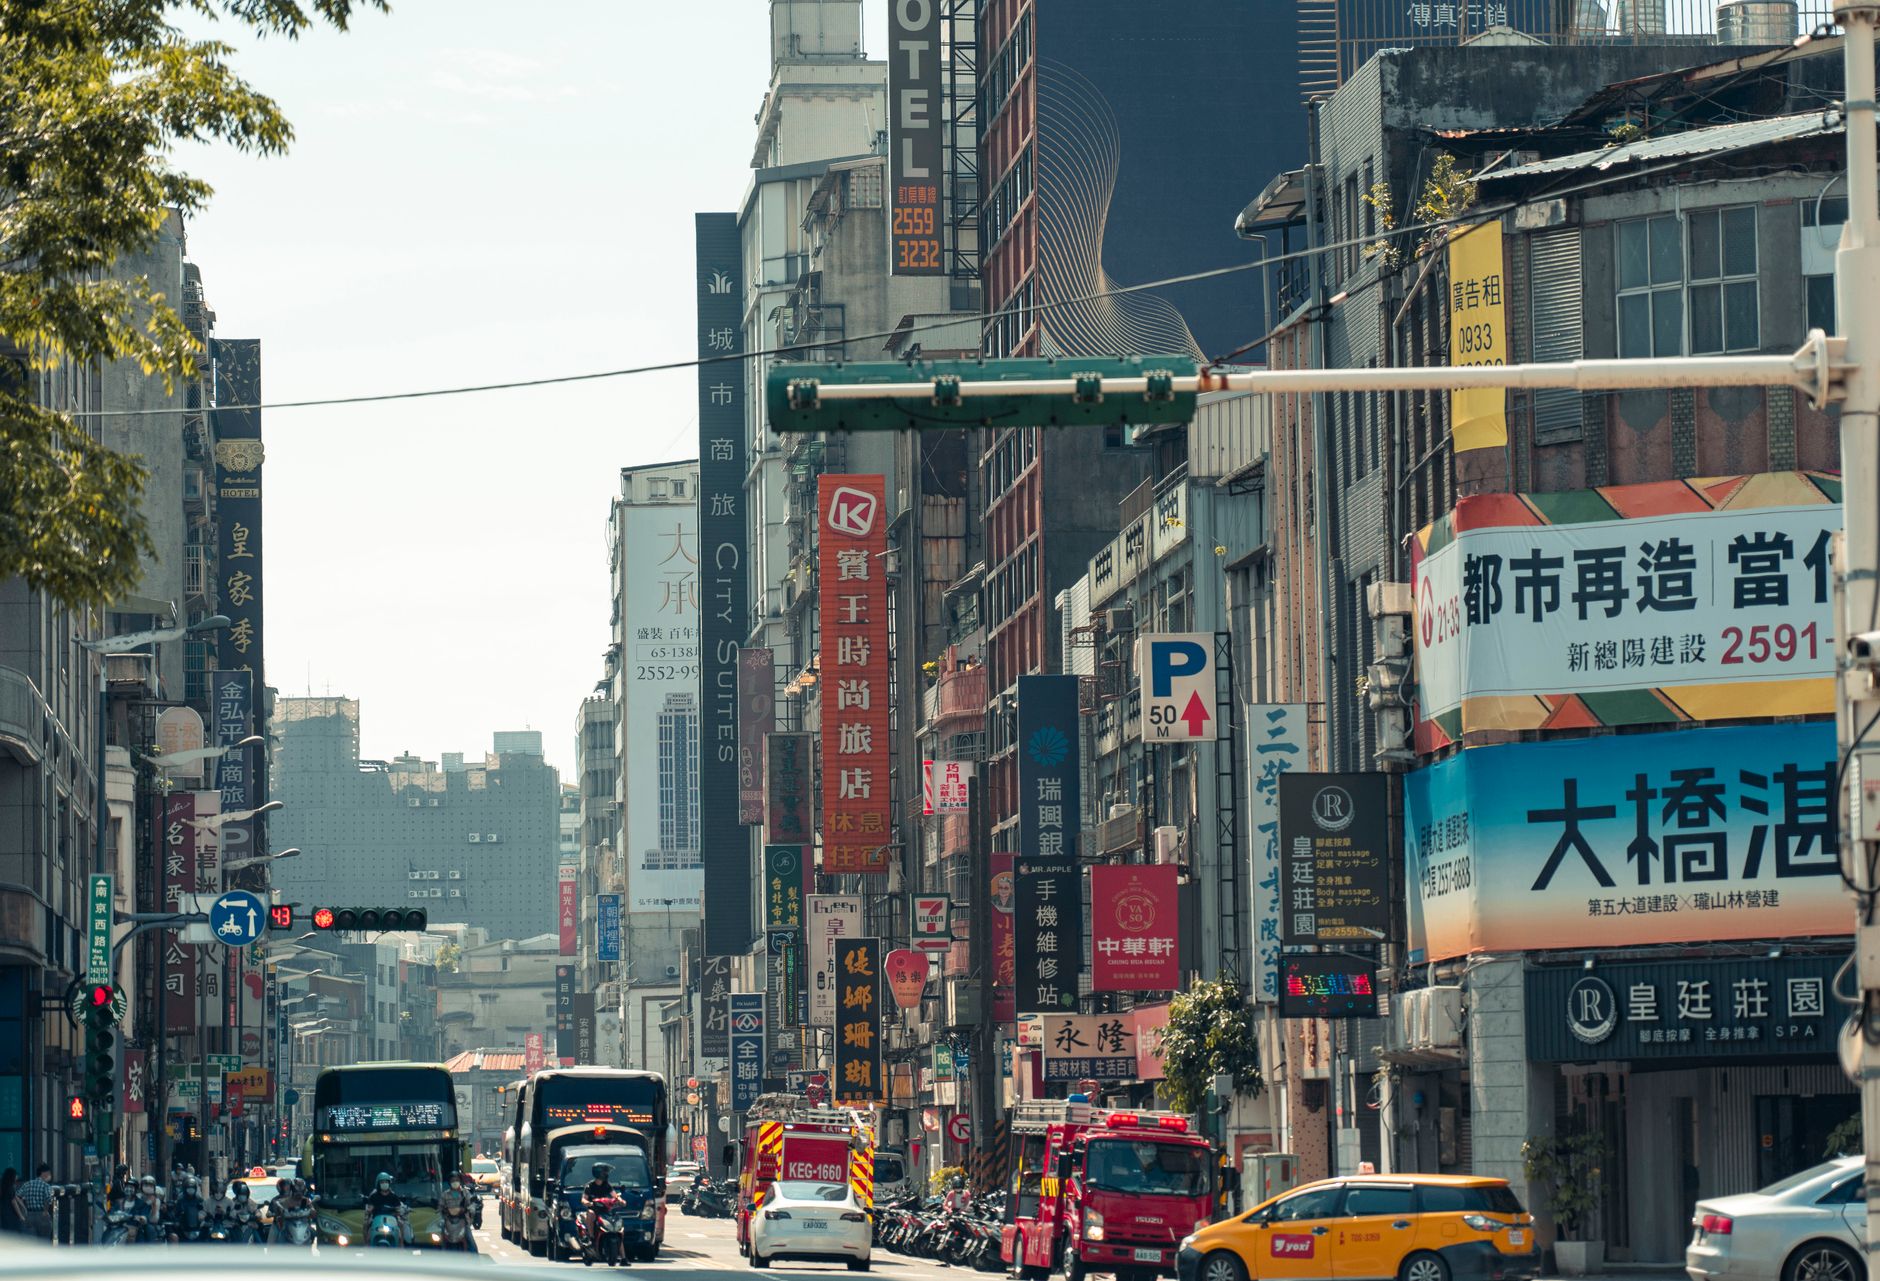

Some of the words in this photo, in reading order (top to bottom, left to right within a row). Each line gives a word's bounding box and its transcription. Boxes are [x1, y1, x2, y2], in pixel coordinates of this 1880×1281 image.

[1407, 2, 1507, 27] 傳真行銷
[893, 207, 934, 235] 2559
[899, 240, 940, 268] 3232
[1452, 274, 1502, 313] 廣告租
[1459, 322, 1493, 354] 0933
[707, 327, 736, 516] 城市商旅
[222, 489, 258, 498] HOTEL
[227, 521, 254, 672] 皇家季
[716, 542, 739, 624] CITY
[1463, 538, 1699, 627] 都市再造
[637, 627, 663, 641] 盛裝
[669, 627, 703, 641] 百年
[1151, 641, 1207, 697] P
[1567, 633, 1707, 673] 新總陽建設
[836, 549, 873, 800] 賓王時尚旅店
[717, 638, 741, 762] SUITES
[1149, 705, 1177, 725] 50
[220, 680, 245, 813] 金弘平價商旅
[1157, 726, 1169, 737] M
[829, 812, 886, 833] 休息
[1527, 760, 1839, 892] 大橋湛
[1315, 849, 1334, 857] Foot
[1337, 850, 1370, 858] massage
[1291, 835, 1315, 937] 皇廷莊園
[1316, 888, 1335, 897] Body
[94, 886, 108, 947] 南京西路
[166, 821, 189, 997] 名家西公司
[271, 905, 291, 926] 43
[1588, 893, 1679, 917] 第五大道建設
[1036, 879, 1059, 1006] 手機維修站
[1097, 937, 1175, 957] 中華軒
[1627, 977, 1825, 1021] 皇廷莊園
[579, 1017, 590, 1059] 安泰銀行
[1055, 1020, 1134, 1054] 永隆
[1639, 1028, 1691, 1043] 腳底按摩
[1704, 1025, 1760, 1041] 全身推拿
[737, 1040, 759, 1080] 全聯
[789, 1074, 804, 1090] P
[788, 1162, 842, 1182] KEG-1660
[1135, 1216, 1163, 1225] ISUZU
[1285, 1240, 1311, 1253] yoxi
